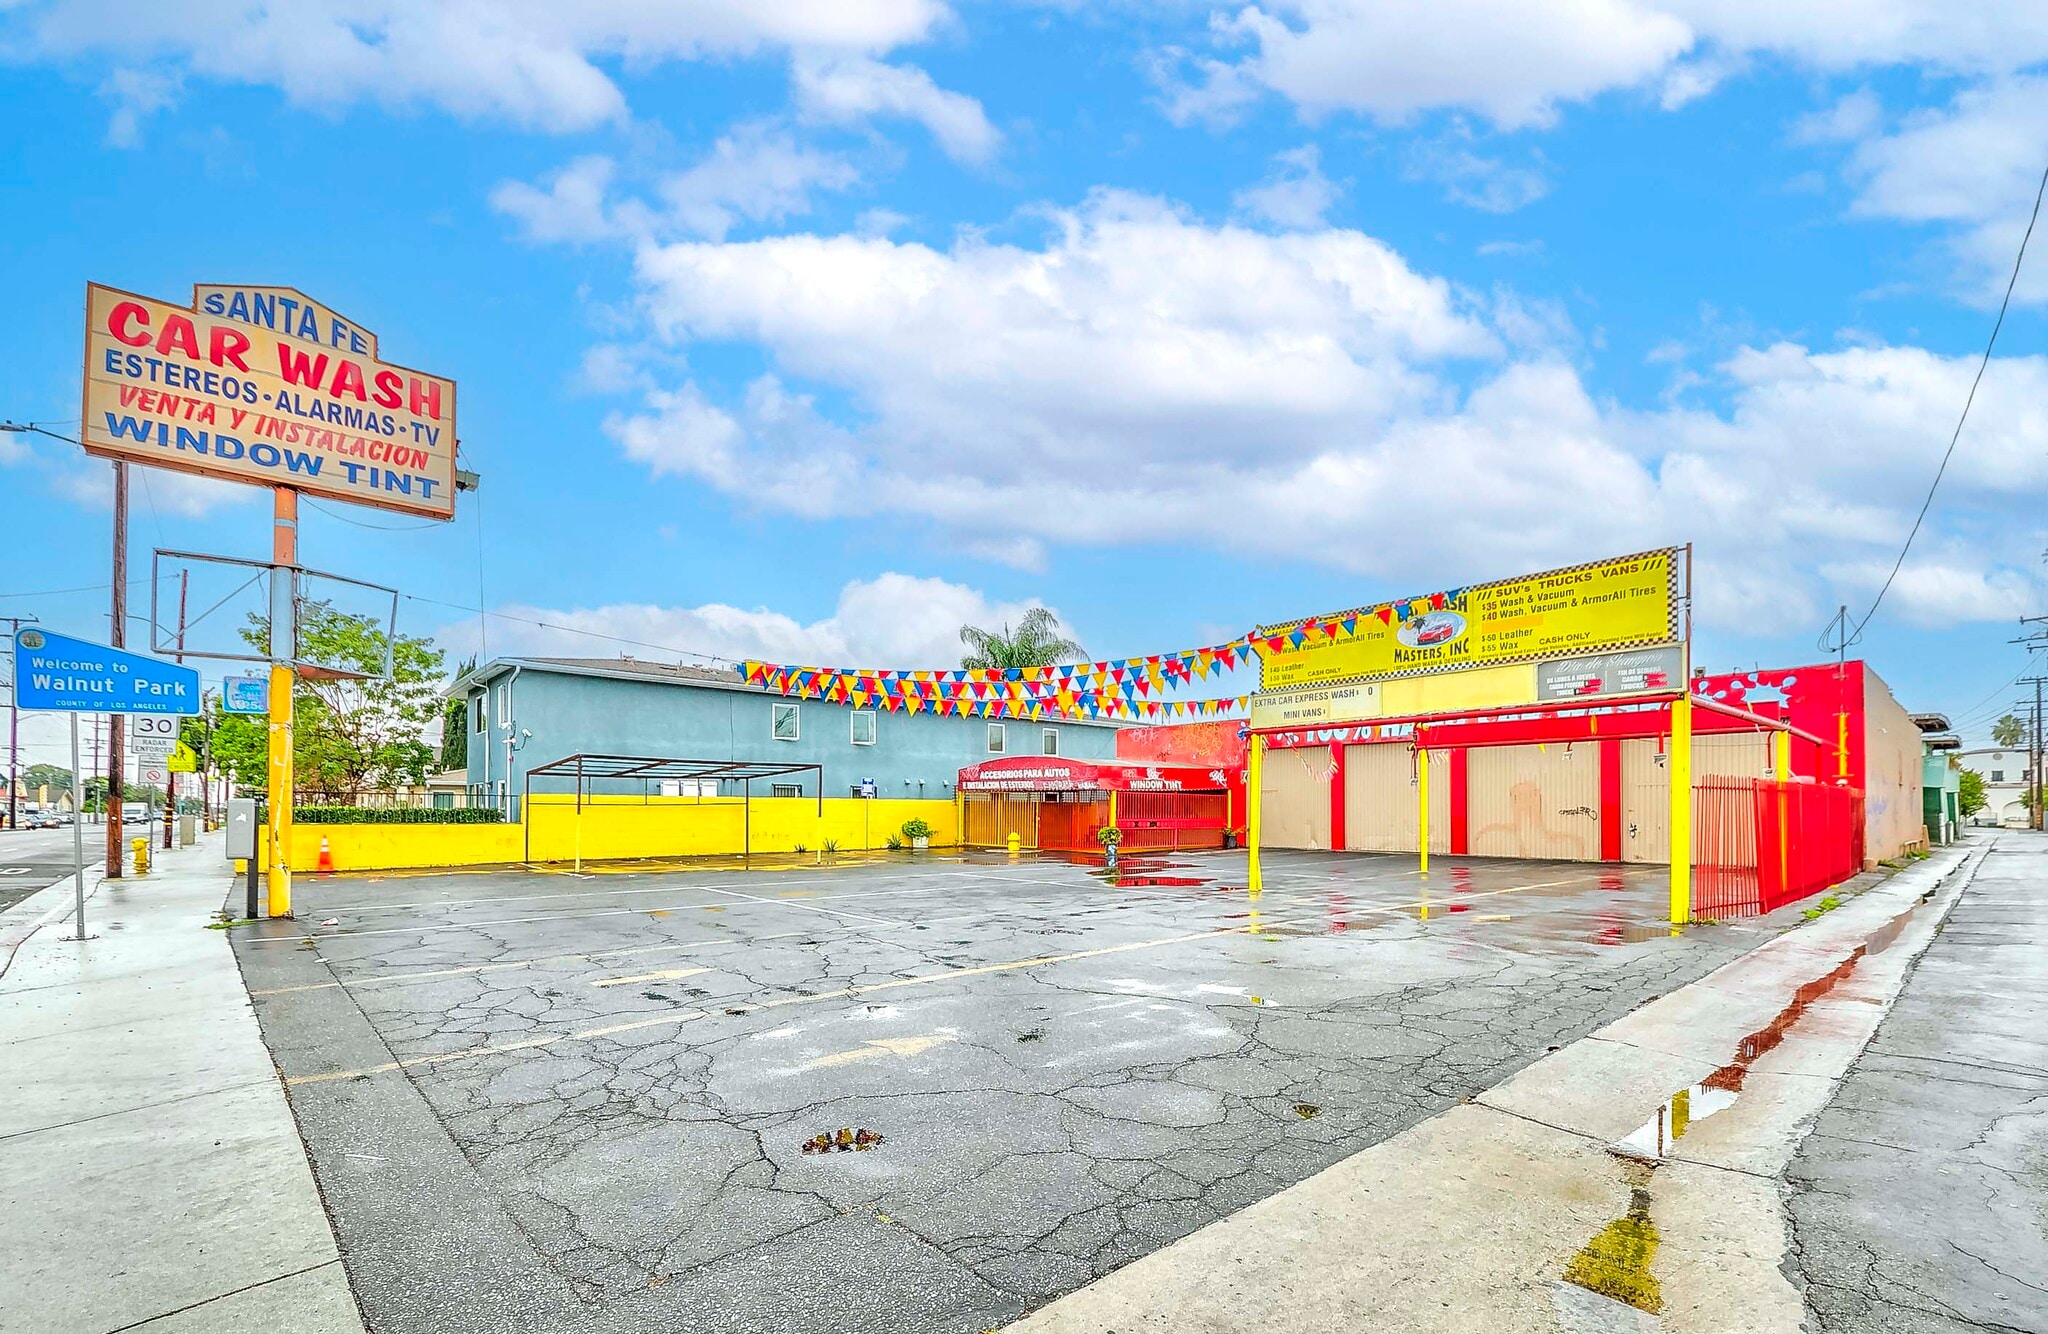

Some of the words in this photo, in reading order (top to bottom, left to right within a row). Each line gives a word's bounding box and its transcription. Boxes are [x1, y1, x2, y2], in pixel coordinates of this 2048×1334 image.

[204, 292, 319, 343] SANTA
[331, 317, 367, 355] FE
[107, 301, 251, 373] CAR
[277, 342, 441, 421] WASH
[106, 348, 258, 404] ESTEREOS
[276, 390, 396, 436] ALARMAS
[411, 421, 440, 448] TV
[119, 384, 216, 425] VENTA
[231, 409, 247, 432] Y
[254, 415, 430, 471] INSTALACION
[105, 412, 324, 477] WINDOW
[339, 461, 440, 499] TINT
[1496, 585, 1531, 598] SUV's
[1538, 572, 1593, 590] TRUCKS
[1601, 563, 1639, 579] VANS
[1481, 601, 1498, 611] $35
[1500, 595, 1525, 608] Wash
[1527, 593, 1534, 604] &
[1537, 588, 1576, 602] Vacuum
[1481, 611, 1498, 622] $40
[1531, 601, 1568, 614] Vacuum
[1570, 597, 1578, 607] &
[1581, 588, 1627, 606] ArmorAll
[1630, 585, 1657, 598] Tires
[1302, 641, 1328, 651] Vacuum
[1367, 631, 1385, 640] Tires
[1499, 628, 1533, 640] Leather
[1539, 636, 1564, 645] CASH
[1566, 631, 1591, 641] ONLY
[1394, 647, 1446, 664] MASTERS,
[1450, 637, 1469, 657] INC
[1499, 641, 1519, 651] Wax
[32, 657, 104, 672] Welcome
[112, 662, 128, 674] to
[1281, 662, 1304, 672] Leather
[1308, 669, 1324, 677] CASH
[1325, 667, 1341, 675] ONLY
[32, 674, 115, 693] Walnut
[134, 679, 187, 696] Park
[133, 703, 167, 711] ANGELES
[1254, 697, 1277, 708] EXTRA
[1279, 695, 1293, 706] CAR
[1295, 691, 1329, 704] EXPRESS
[1283, 709, 1300, 720] MINI
[139, 718, 172, 734] 30
[980, 770, 1022, 780] ACCESORIOS
[1024, 769, 1043, 778] PARA
[1044, 768, 1070, 778] AUTOS
[1130, 780, 1163, 790] WINDOW
[1165, 780, 1183, 790] TINT
